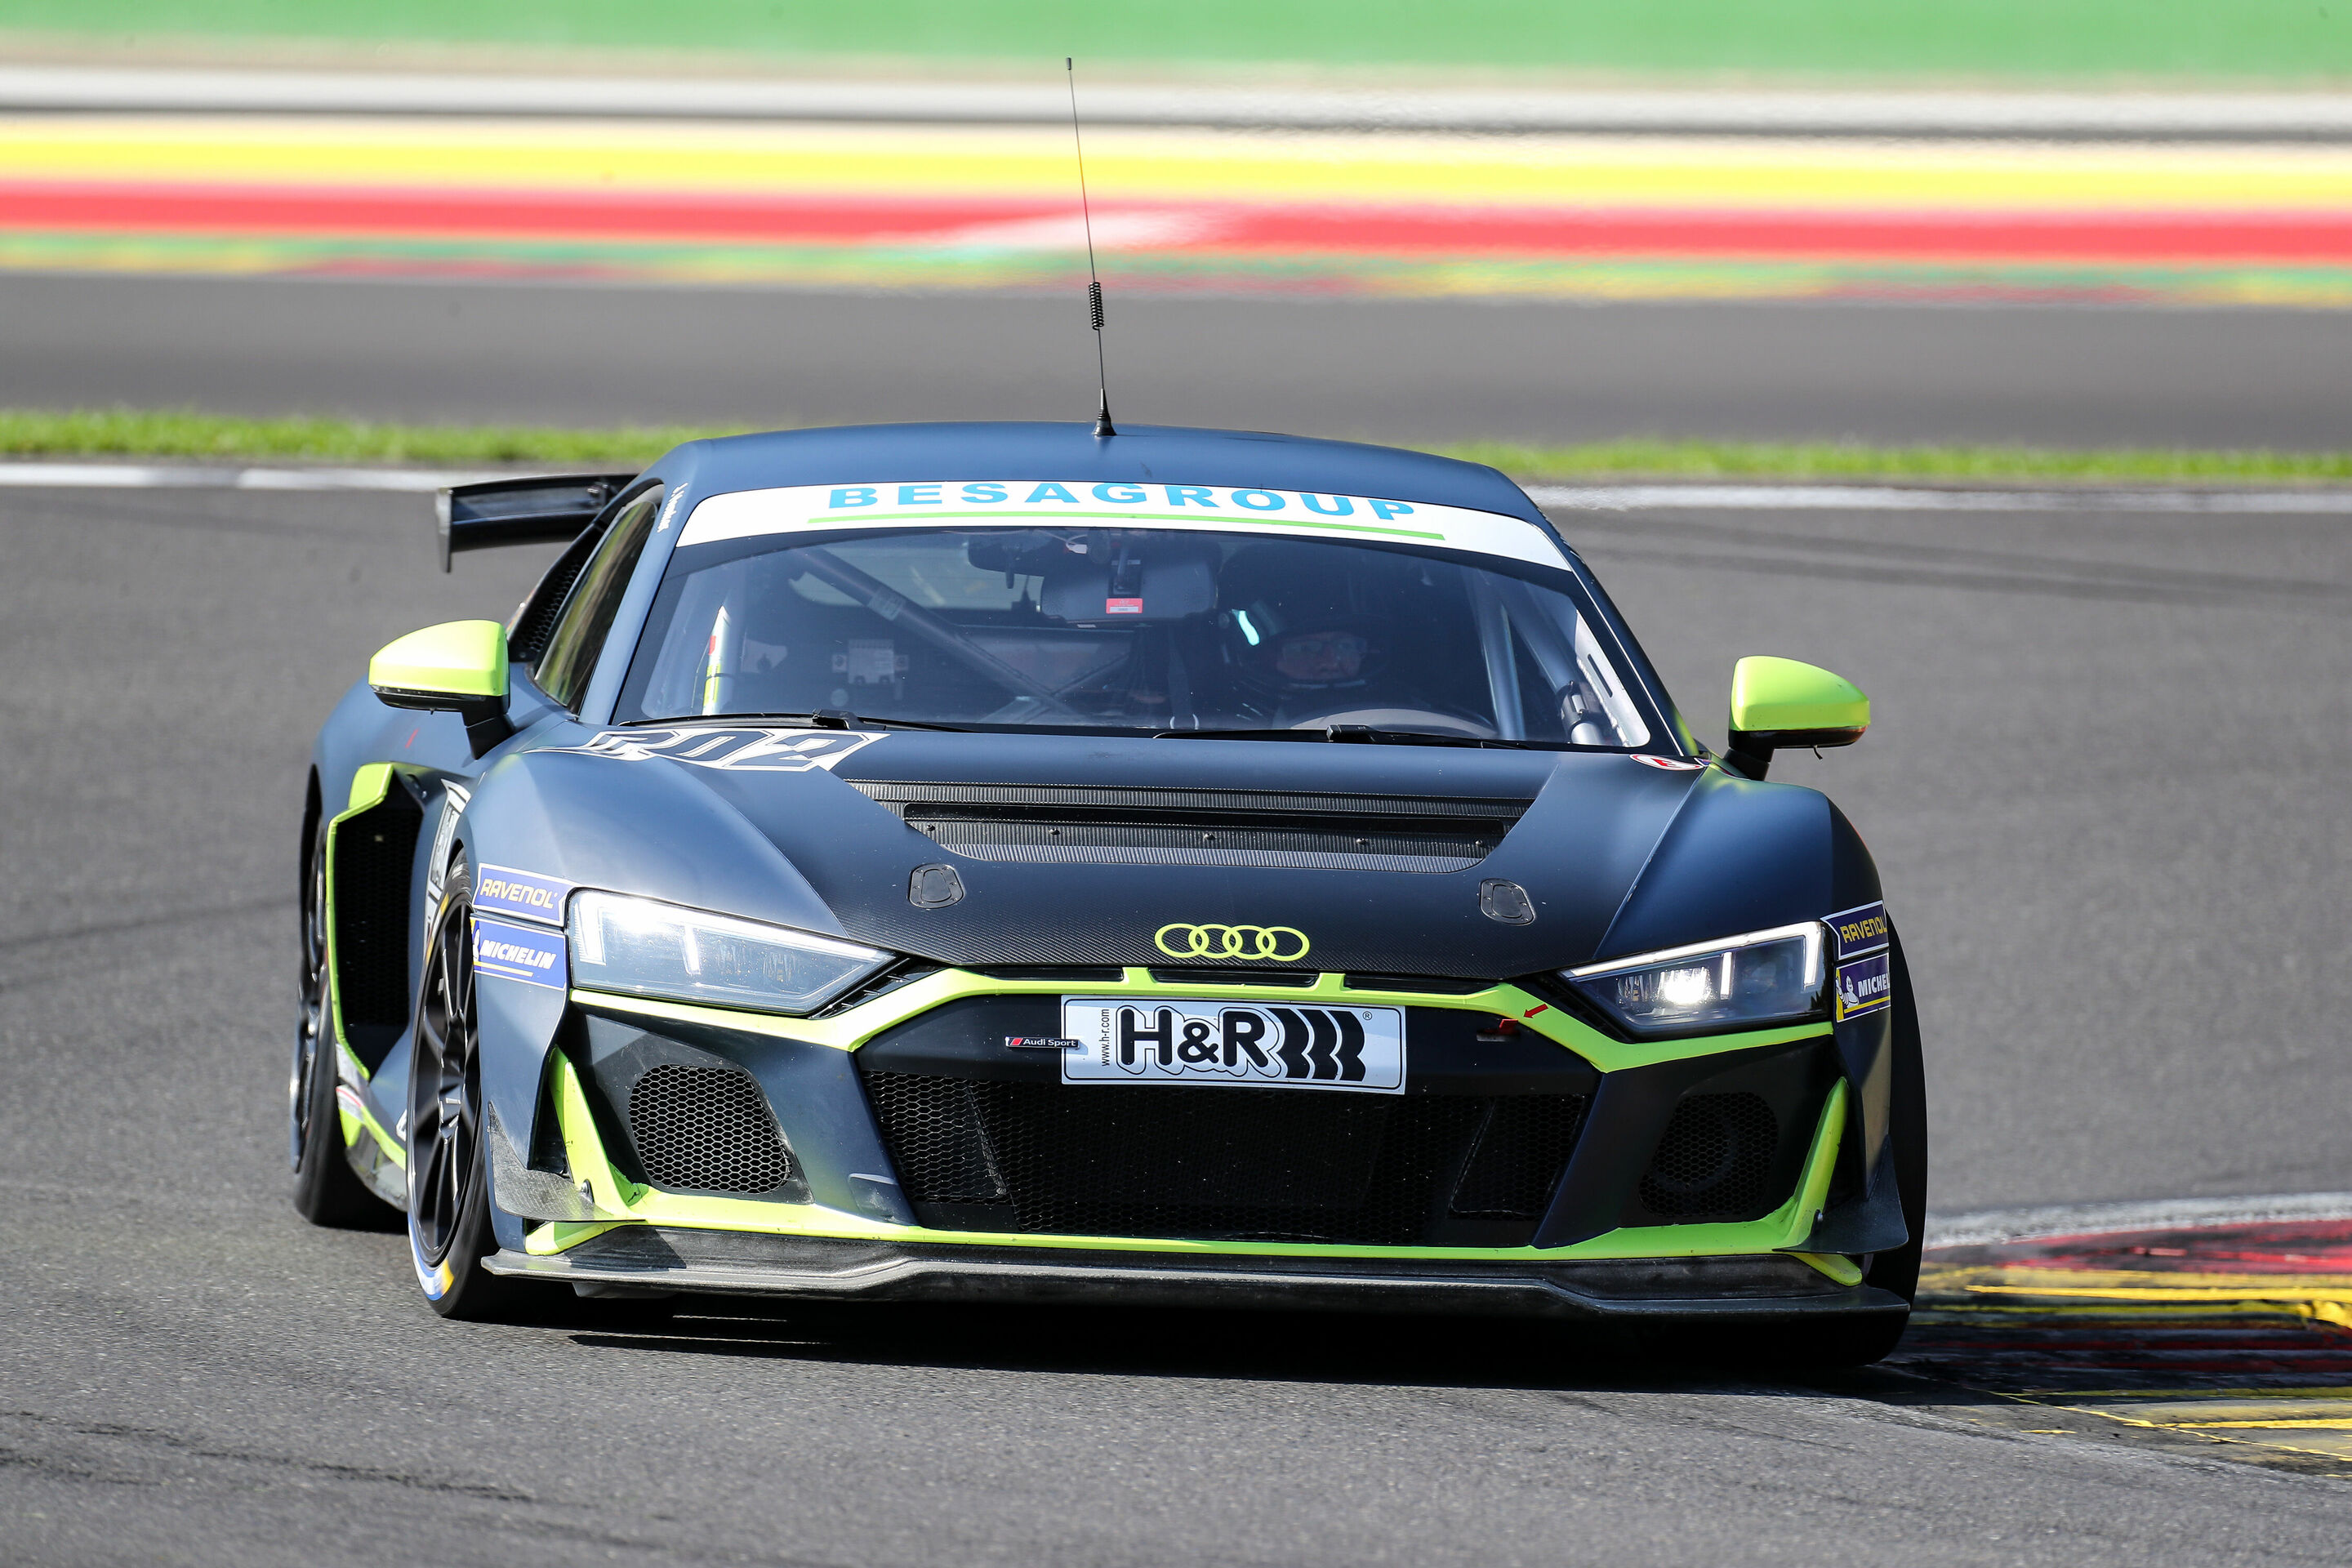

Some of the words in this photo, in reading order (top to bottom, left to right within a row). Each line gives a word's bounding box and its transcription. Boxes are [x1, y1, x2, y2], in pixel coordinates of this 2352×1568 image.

[828, 482, 1416, 521] BESAGROUP
[479, 878, 555, 910] RAVENOL
[1840, 916, 1887, 943] RAVENOL
[479, 939, 557, 969] MICHELIN
[1857, 973, 1891, 998] MICHEL
[1022, 1038, 1046, 1046] Audi
[1047, 1039, 1076, 1048] Sport
[1098, 1009, 1110, 1067] www.h-r.com
[1120, 1008, 1269, 1068] H&R
